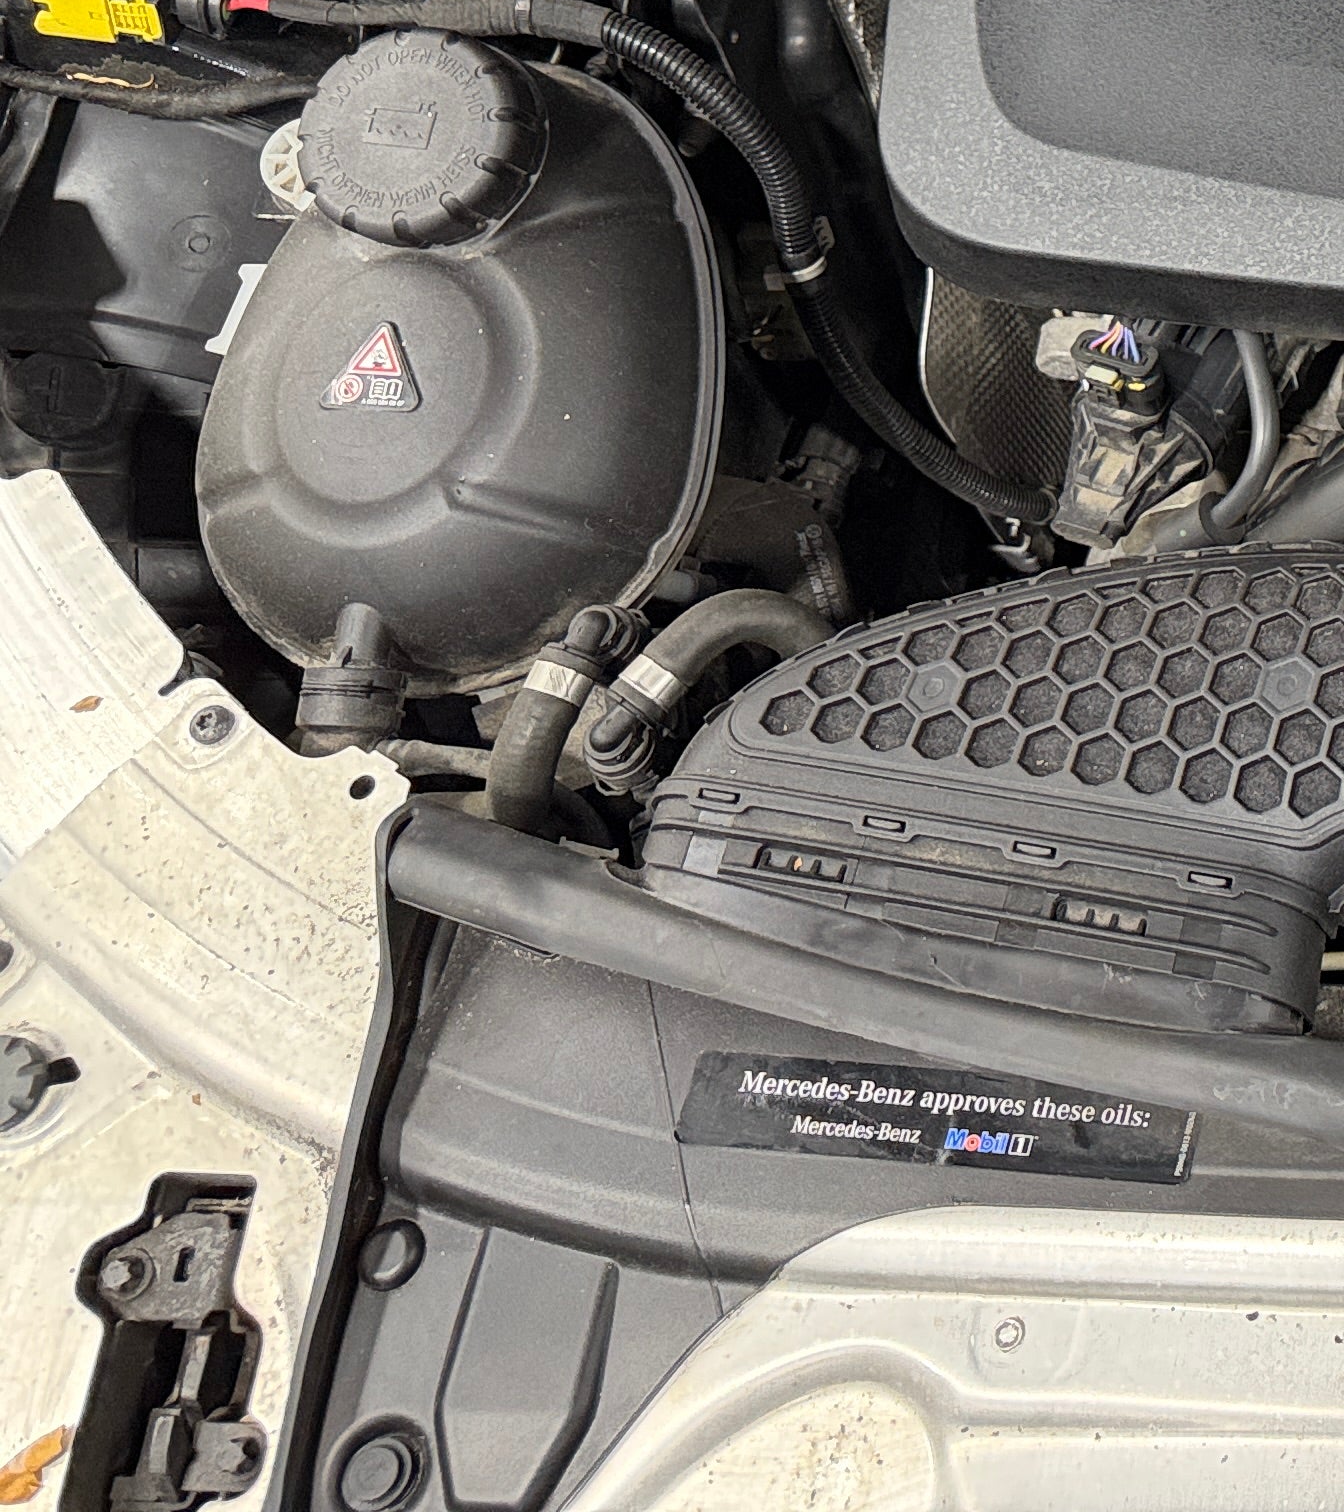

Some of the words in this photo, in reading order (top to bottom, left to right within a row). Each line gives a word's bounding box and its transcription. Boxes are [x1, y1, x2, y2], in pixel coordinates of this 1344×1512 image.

[352, 55, 381, 86] NOT
[388, 48, 434, 66] OPEN
[434, 53, 476, 90] WHEN
[464, 88, 486, 124] HOT
[317, 127, 341, 173] NICHT
[389, 180, 437, 209] WENN
[738, 1070, 916, 1107] Mercedes-Benz
[919, 1090, 1027, 1116] approves
[1031, 1096, 1097, 1123] these
[1101, 1103, 1151, 1128] oils:
[790, 1114, 922, 1144] Mercedes-Benz
